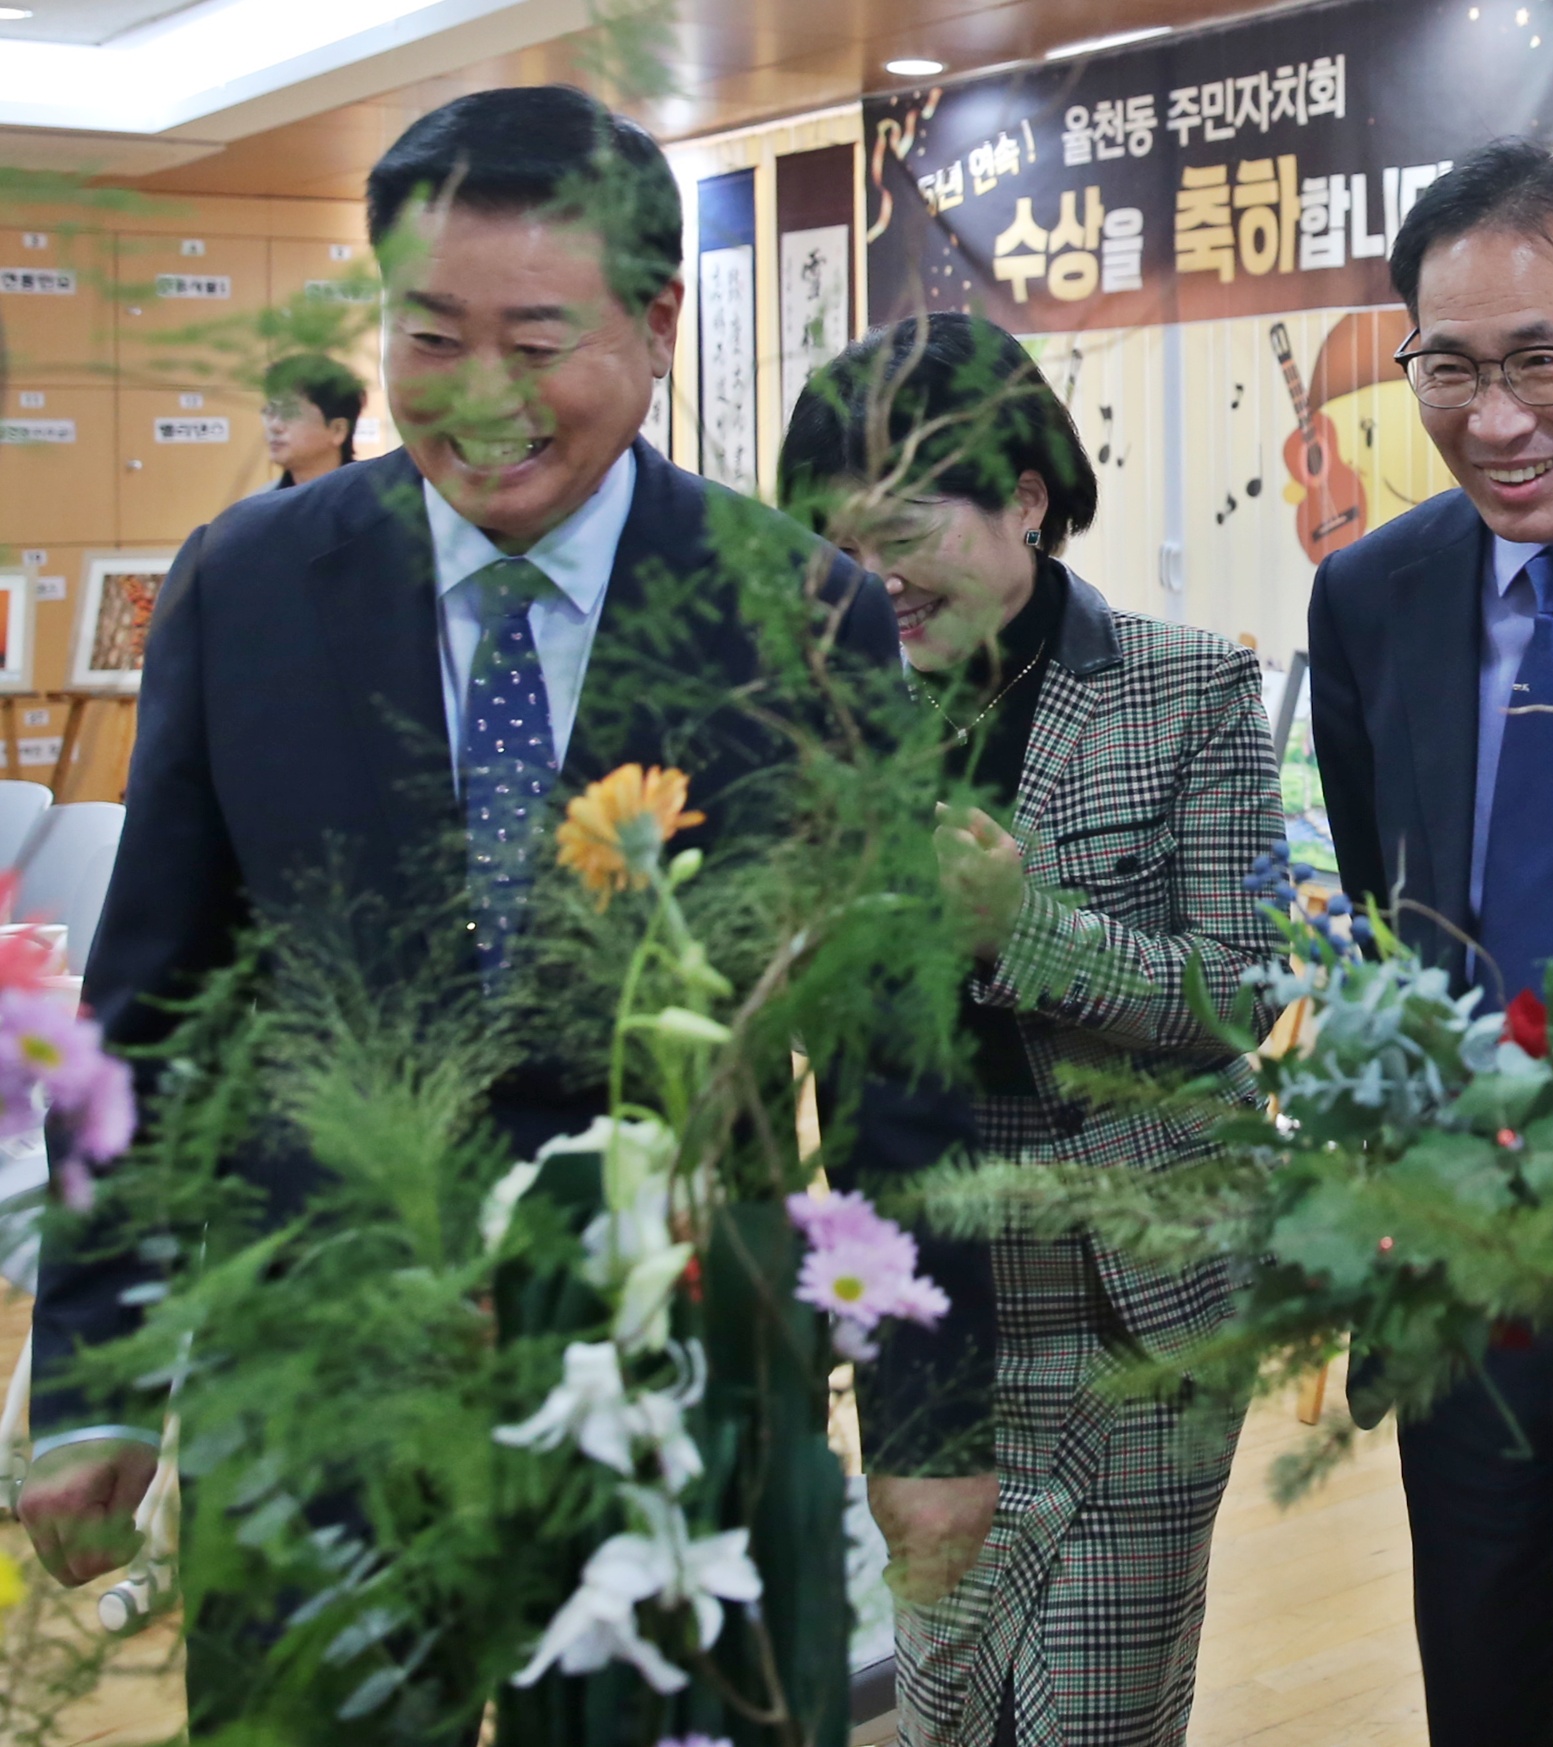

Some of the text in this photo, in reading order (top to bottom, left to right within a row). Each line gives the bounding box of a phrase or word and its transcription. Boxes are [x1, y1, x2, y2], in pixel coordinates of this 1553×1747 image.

[1061, 54, 1347, 167] 율천동 주민자치회
[993, 185, 1144, 303] 수상을
